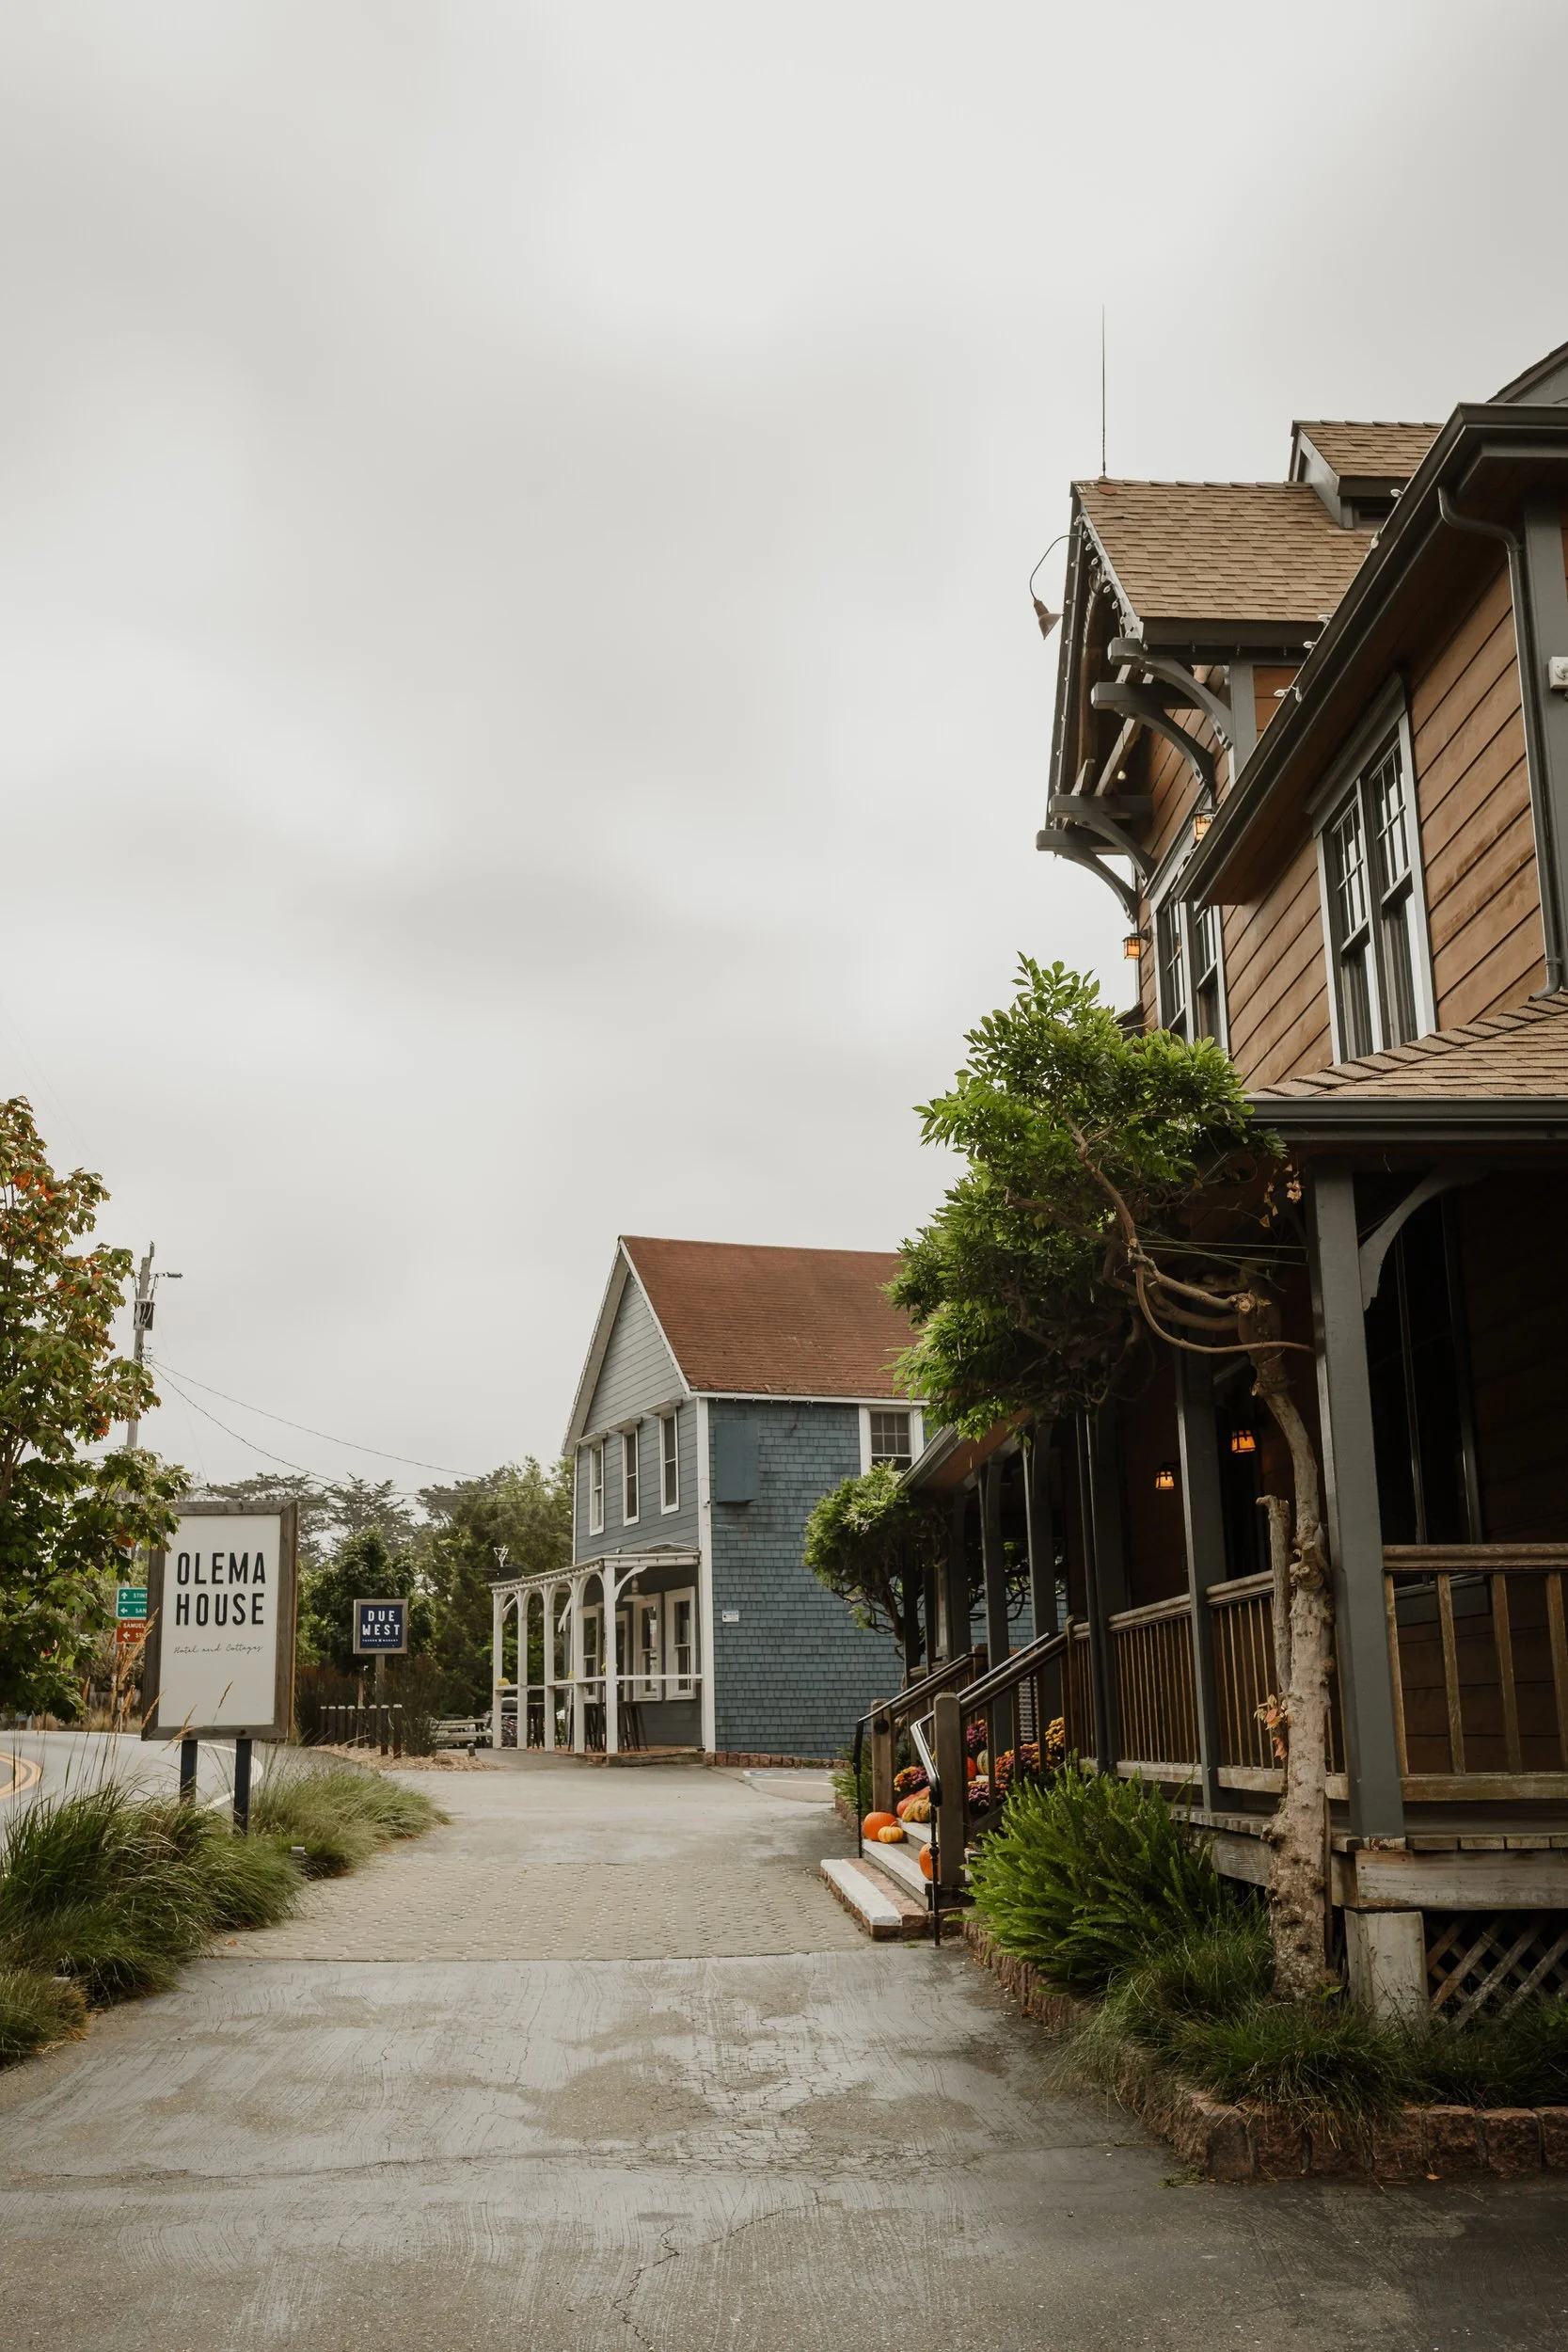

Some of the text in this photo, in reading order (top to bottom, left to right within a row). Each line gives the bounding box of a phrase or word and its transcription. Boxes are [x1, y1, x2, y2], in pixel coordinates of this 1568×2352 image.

[177, 1552, 266, 1585] OLEMA
[176, 1593, 264, 1627] HOUSE
[368, 1610, 395, 1622] DUE
[362, 1624, 401, 1635] WEST
[173, 1645, 198, 1653] Hotel
[202, 1643, 221, 1652] and
